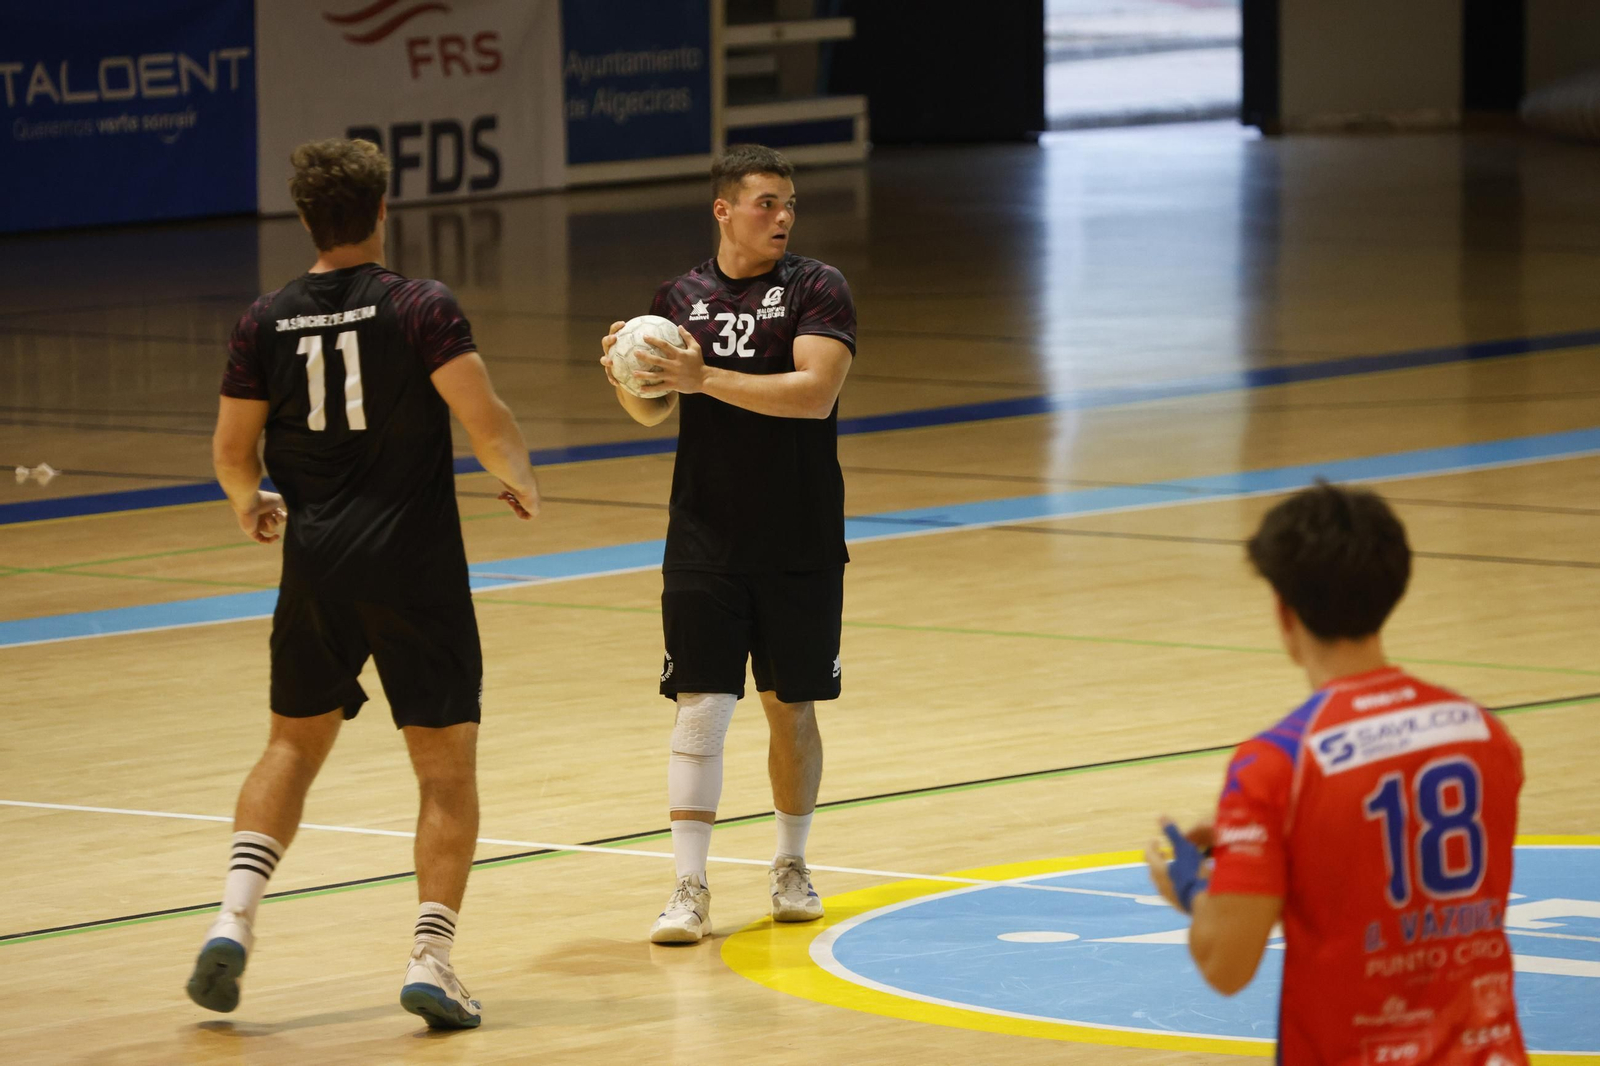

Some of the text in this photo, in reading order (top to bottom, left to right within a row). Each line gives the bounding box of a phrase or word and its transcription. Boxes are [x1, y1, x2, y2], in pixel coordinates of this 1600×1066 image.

[405, 31, 502, 79] FRS
[564, 46, 703, 86] Ayuntamiento
[96, 111, 140, 133] verte
[712, 312, 756, 357] 32
[296, 330, 367, 431] 11
[1363, 753, 1489, 909] 18
